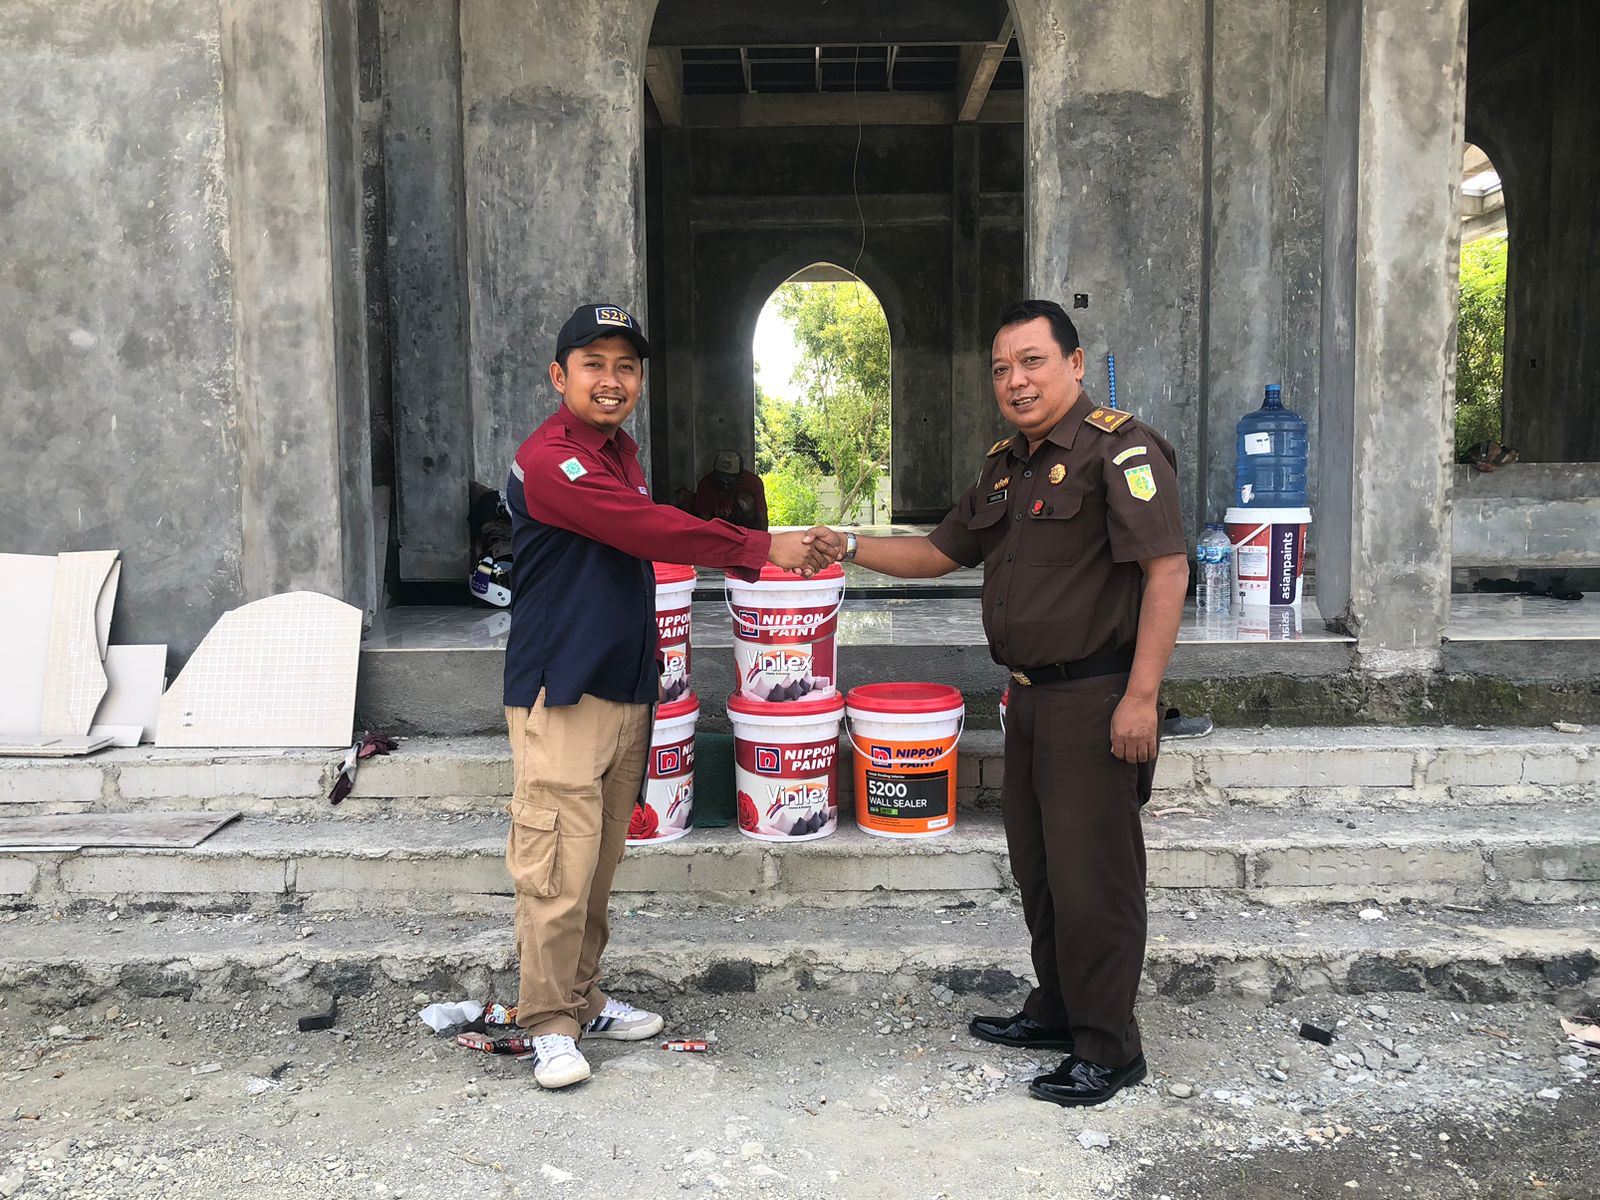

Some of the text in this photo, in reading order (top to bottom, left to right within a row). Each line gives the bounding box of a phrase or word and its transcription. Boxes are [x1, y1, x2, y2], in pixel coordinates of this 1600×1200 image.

[601, 310, 628, 322] S2P
[1280, 531, 1295, 600] asianpaints
[762, 613, 824, 625] NIPPON
[746, 649, 815, 671] Vinilex
[784, 744, 836, 760] NIPPON
[896, 747, 943, 758] NIPPON
[791, 757, 833, 772] PAINT
[765, 784, 829, 806] Vinilex
[869, 780, 908, 797] 5200
[869, 797, 927, 808] WALL SEALER
